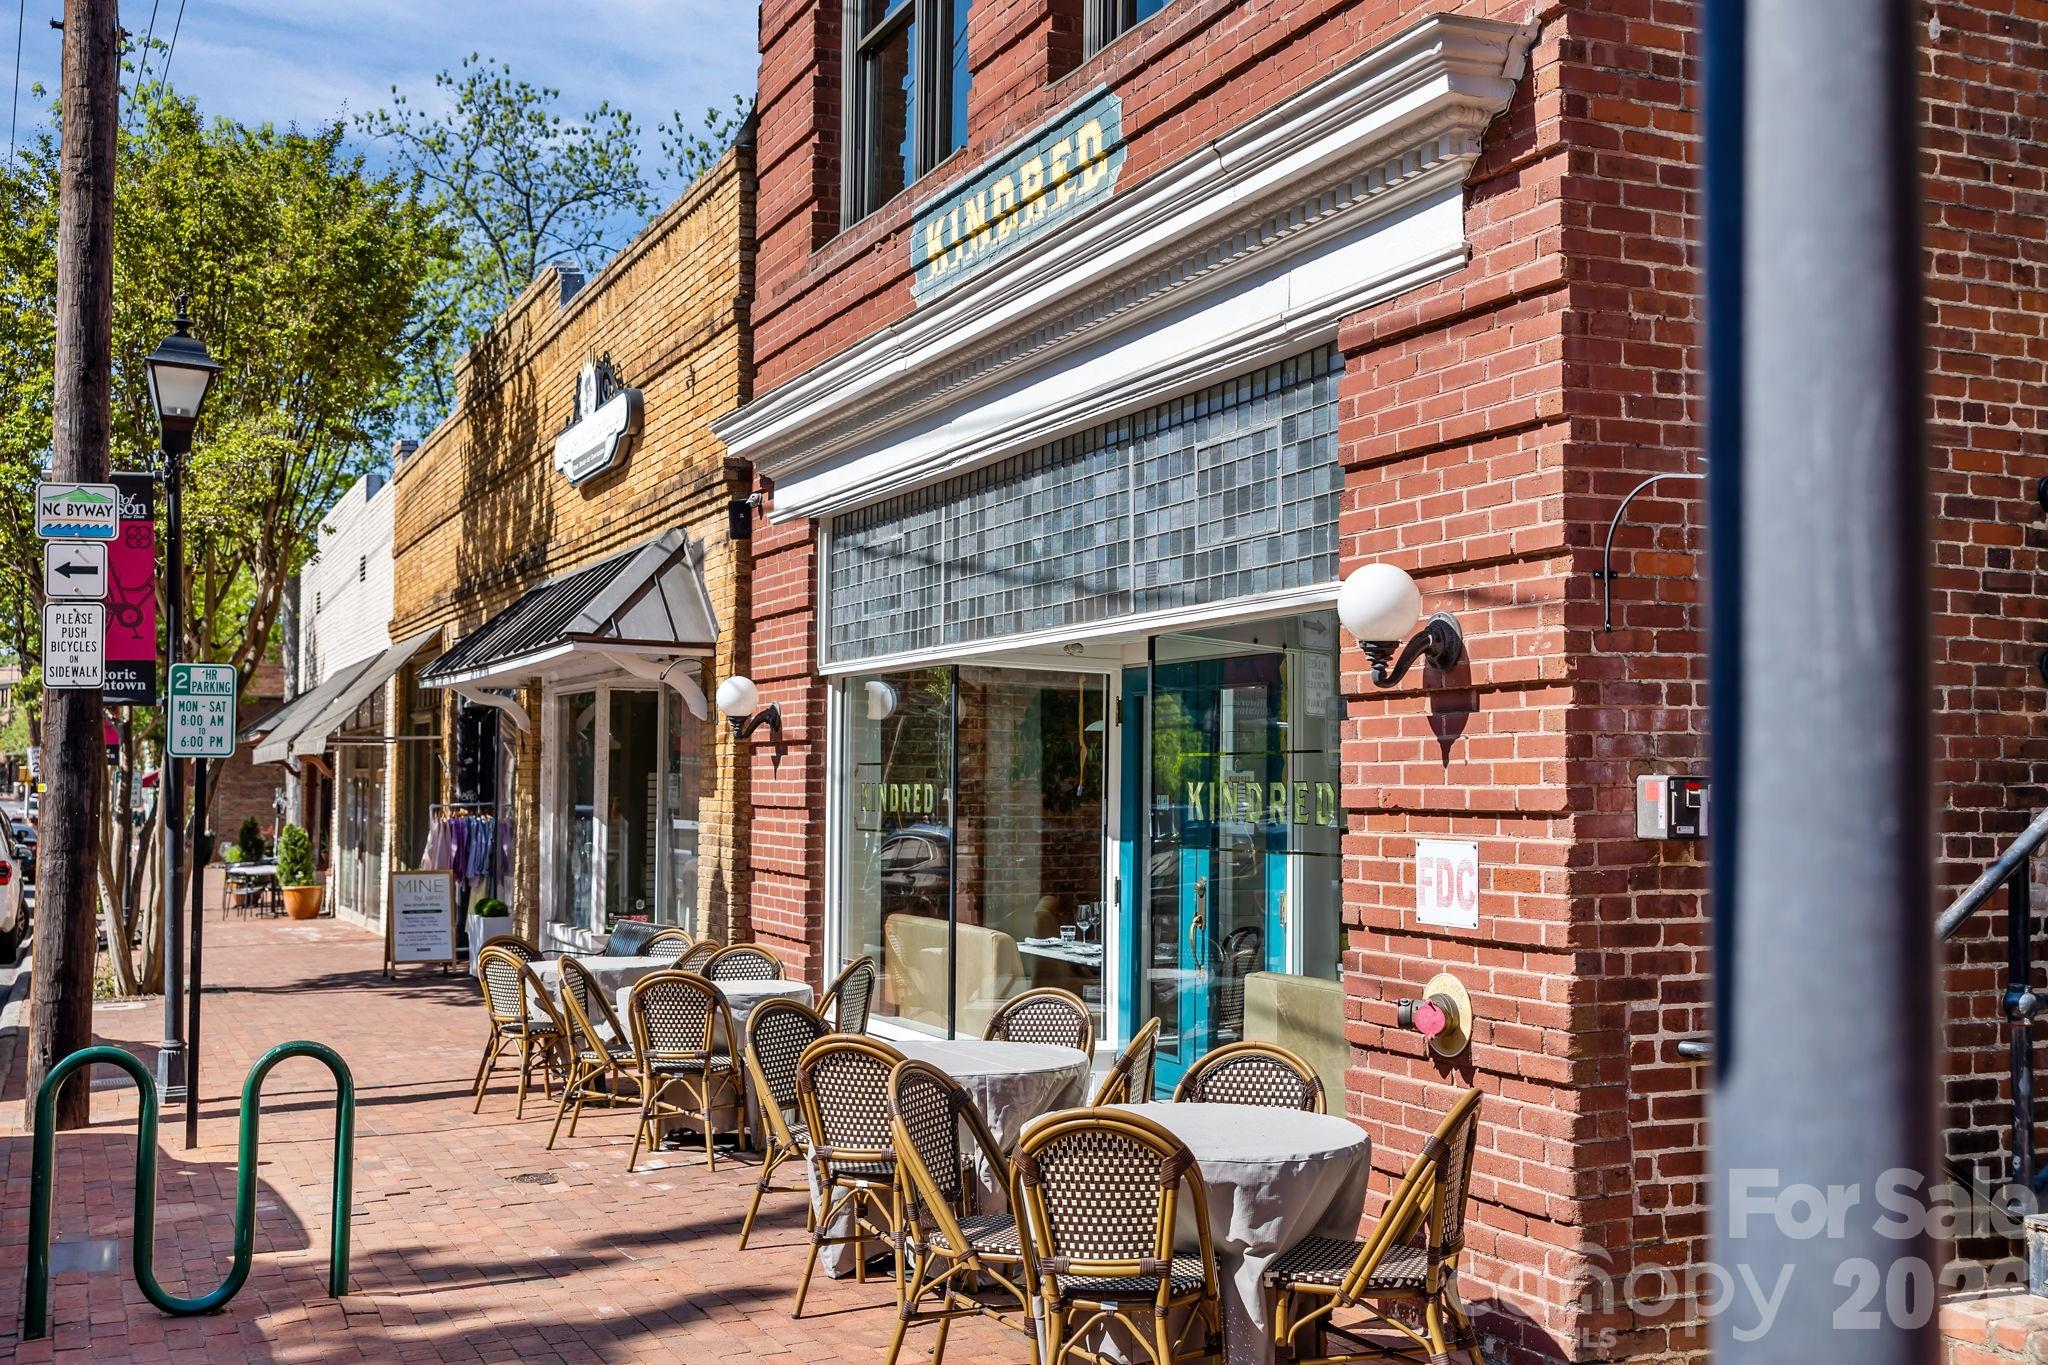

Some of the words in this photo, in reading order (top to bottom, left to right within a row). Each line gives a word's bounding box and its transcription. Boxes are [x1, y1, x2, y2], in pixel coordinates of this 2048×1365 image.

[924, 118, 1108, 284] KINDRED
[42, 502, 61, 516] NC
[67, 503, 113, 517] BYWAY
[56, 613, 93, 625] PLEASE
[61, 627, 87, 639] PUSH
[51, 640, 97, 653] BICYCLES
[69, 655, 79, 663] ON
[49, 666, 98, 678] SIDEWALK
[175, 672, 188, 689] 2
[205, 669, 217, 681] HR
[191, 681, 231, 693] PARKING
[178, 701, 198, 712] MON
[209, 701, 227, 712] SAT
[180, 714, 203, 726] 8:00
[209, 715, 224, 726] AM
[198, 727, 206, 735] TO
[180, 736, 203, 747] 6:00
[209, 736, 223, 747] PM
[861, 783, 934, 813] KINDRED
[1187, 781, 1338, 826] KINDRED
[398, 879, 445, 894] MINE
[1419, 857, 1475, 911] FDC
